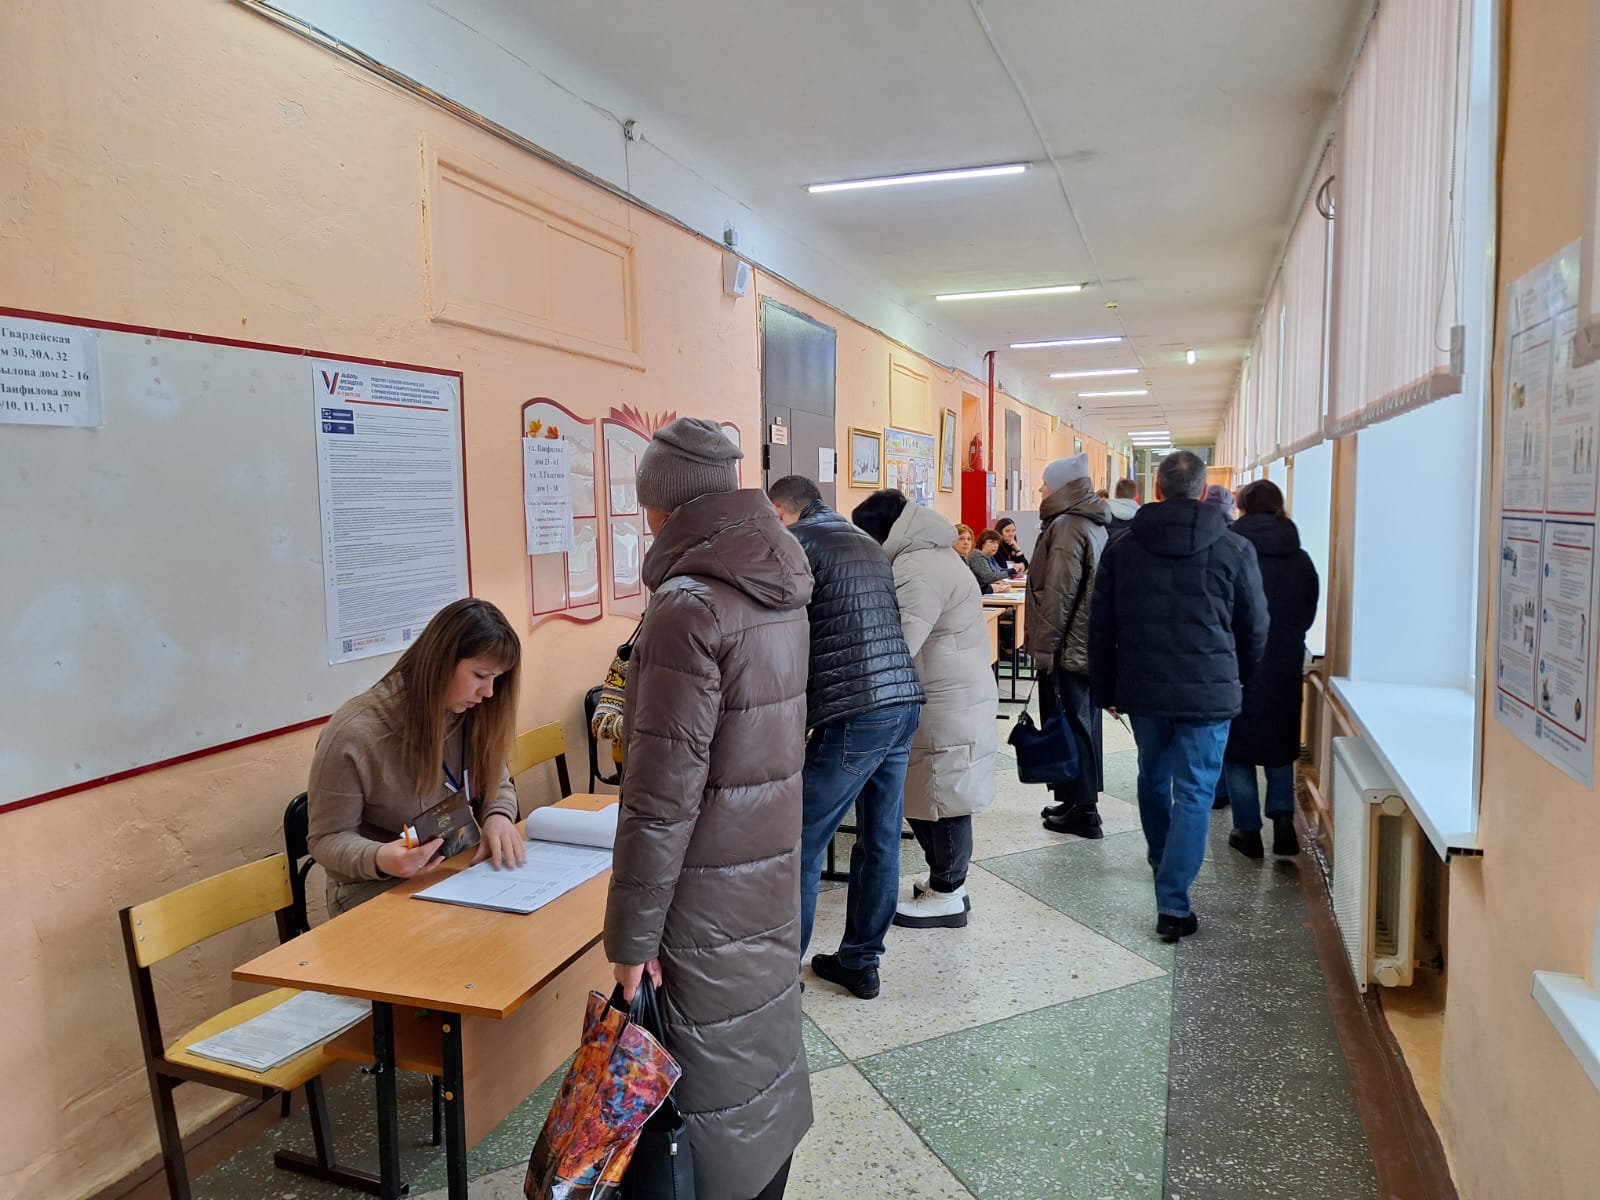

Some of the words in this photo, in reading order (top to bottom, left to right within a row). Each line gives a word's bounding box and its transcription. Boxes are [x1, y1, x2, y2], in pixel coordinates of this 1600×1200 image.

[2, 328, 71, 344] Гвардейская
[56, 352, 68, 362] 32
[0, 367, 36, 377] ылова
[39, 370, 59, 379] дом
[61, 370, 67, 379] 2
[77, 371, 89, 381] 16
[61, 390, 81, 398] дом
[59, 403, 70, 413] 17
